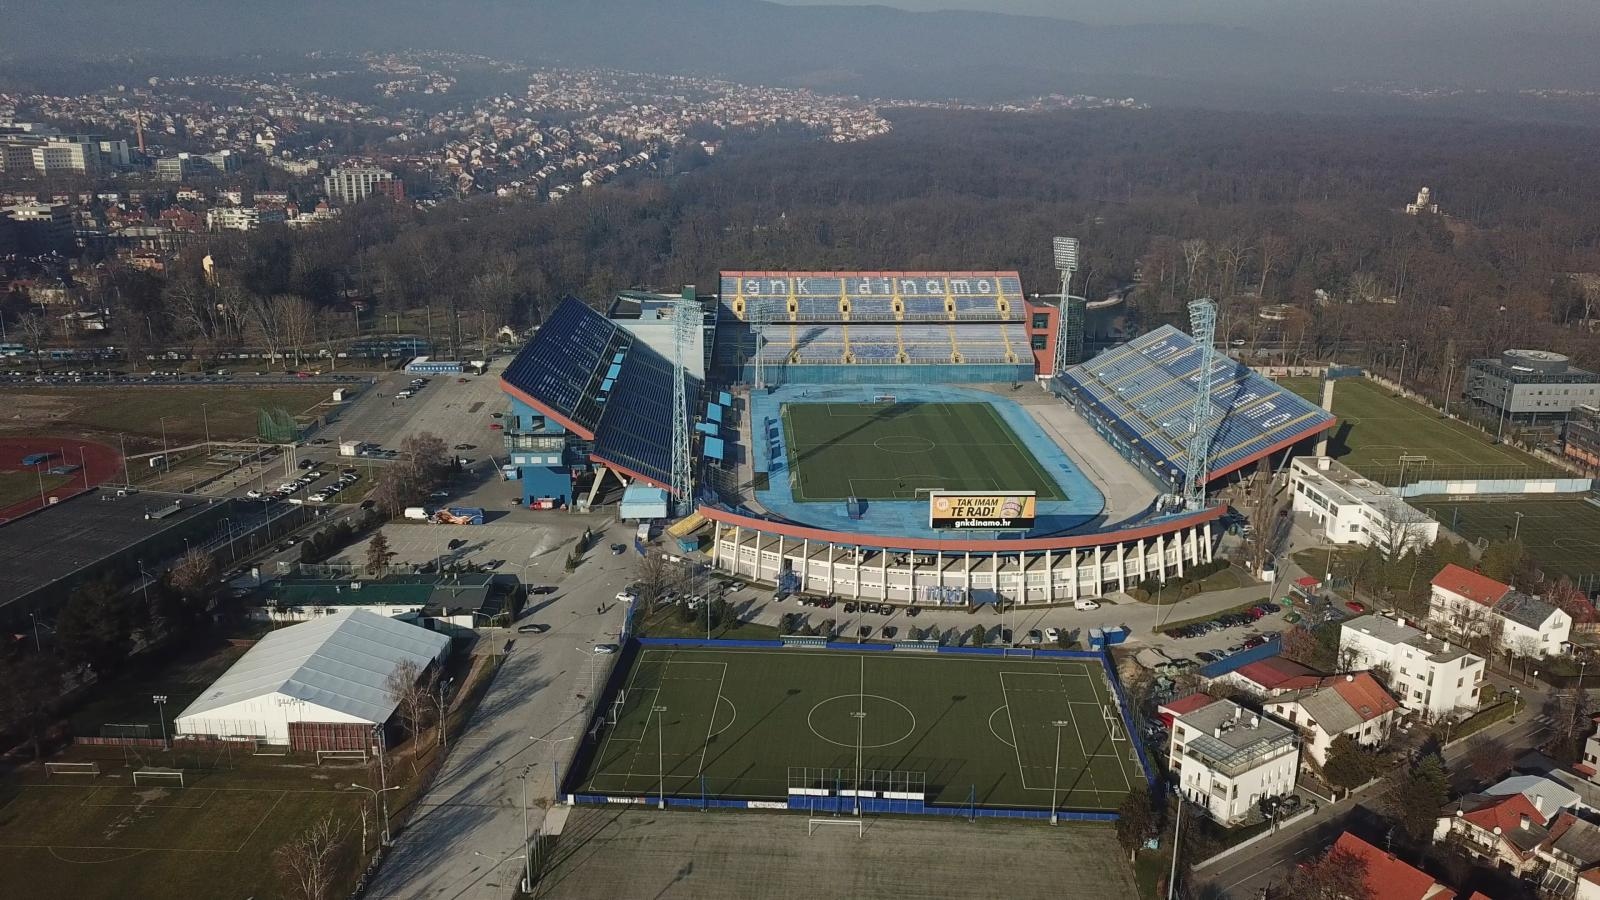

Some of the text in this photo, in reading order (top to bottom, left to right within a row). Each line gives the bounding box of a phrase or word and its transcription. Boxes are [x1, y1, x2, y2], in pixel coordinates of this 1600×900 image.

[746, 276, 991, 295] gnk dinamo
[957, 498, 973, 506] TAK
[974, 498, 998, 506] IMAM
[951, 507, 995, 516] TE RAD!
[955, 519, 1011, 528] gnkdinamo.hr
